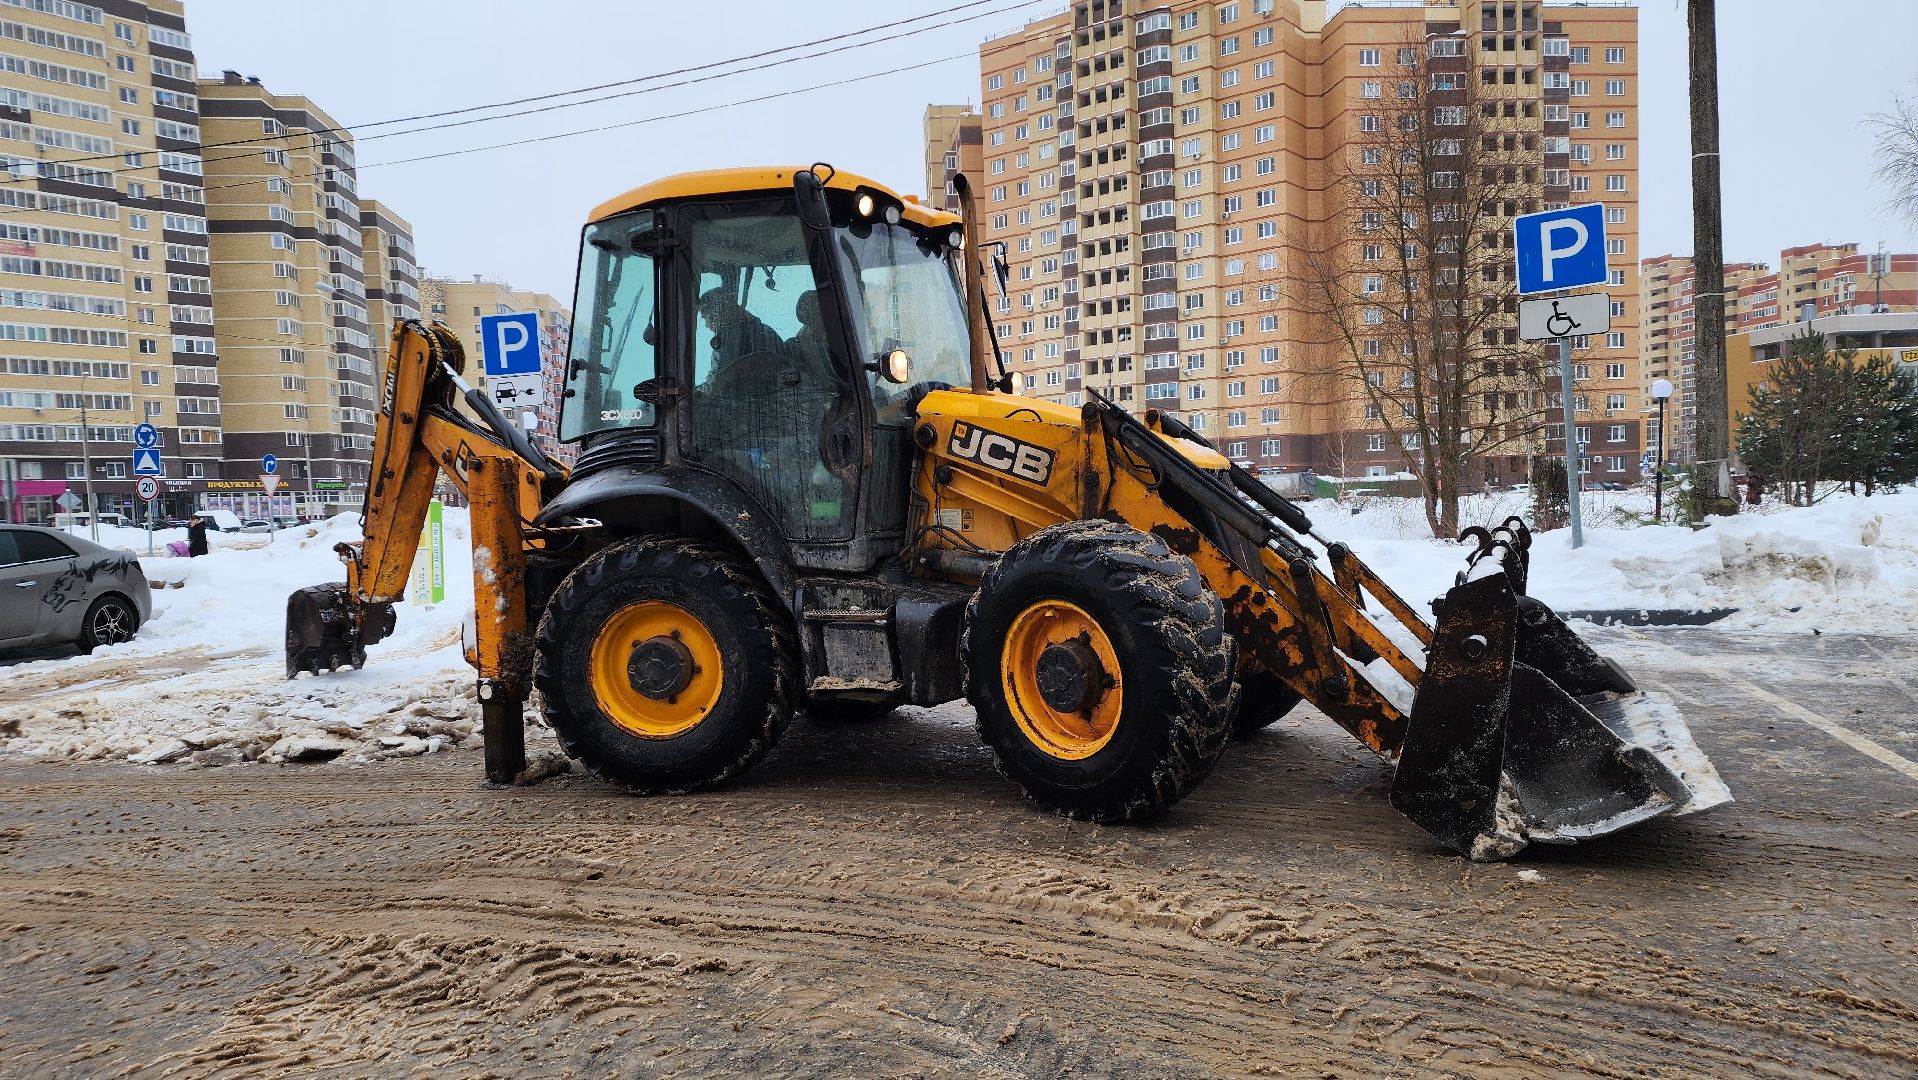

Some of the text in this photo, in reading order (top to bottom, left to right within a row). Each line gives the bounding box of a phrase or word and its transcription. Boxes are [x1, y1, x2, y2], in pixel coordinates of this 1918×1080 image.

[1540, 218, 1589, 282] P
[497, 321, 529, 368] P
[951, 428, 1051, 482] JCB
[142, 482, 154, 493] 20
[207, 481, 255, 489] ПРОДУКТЫ
